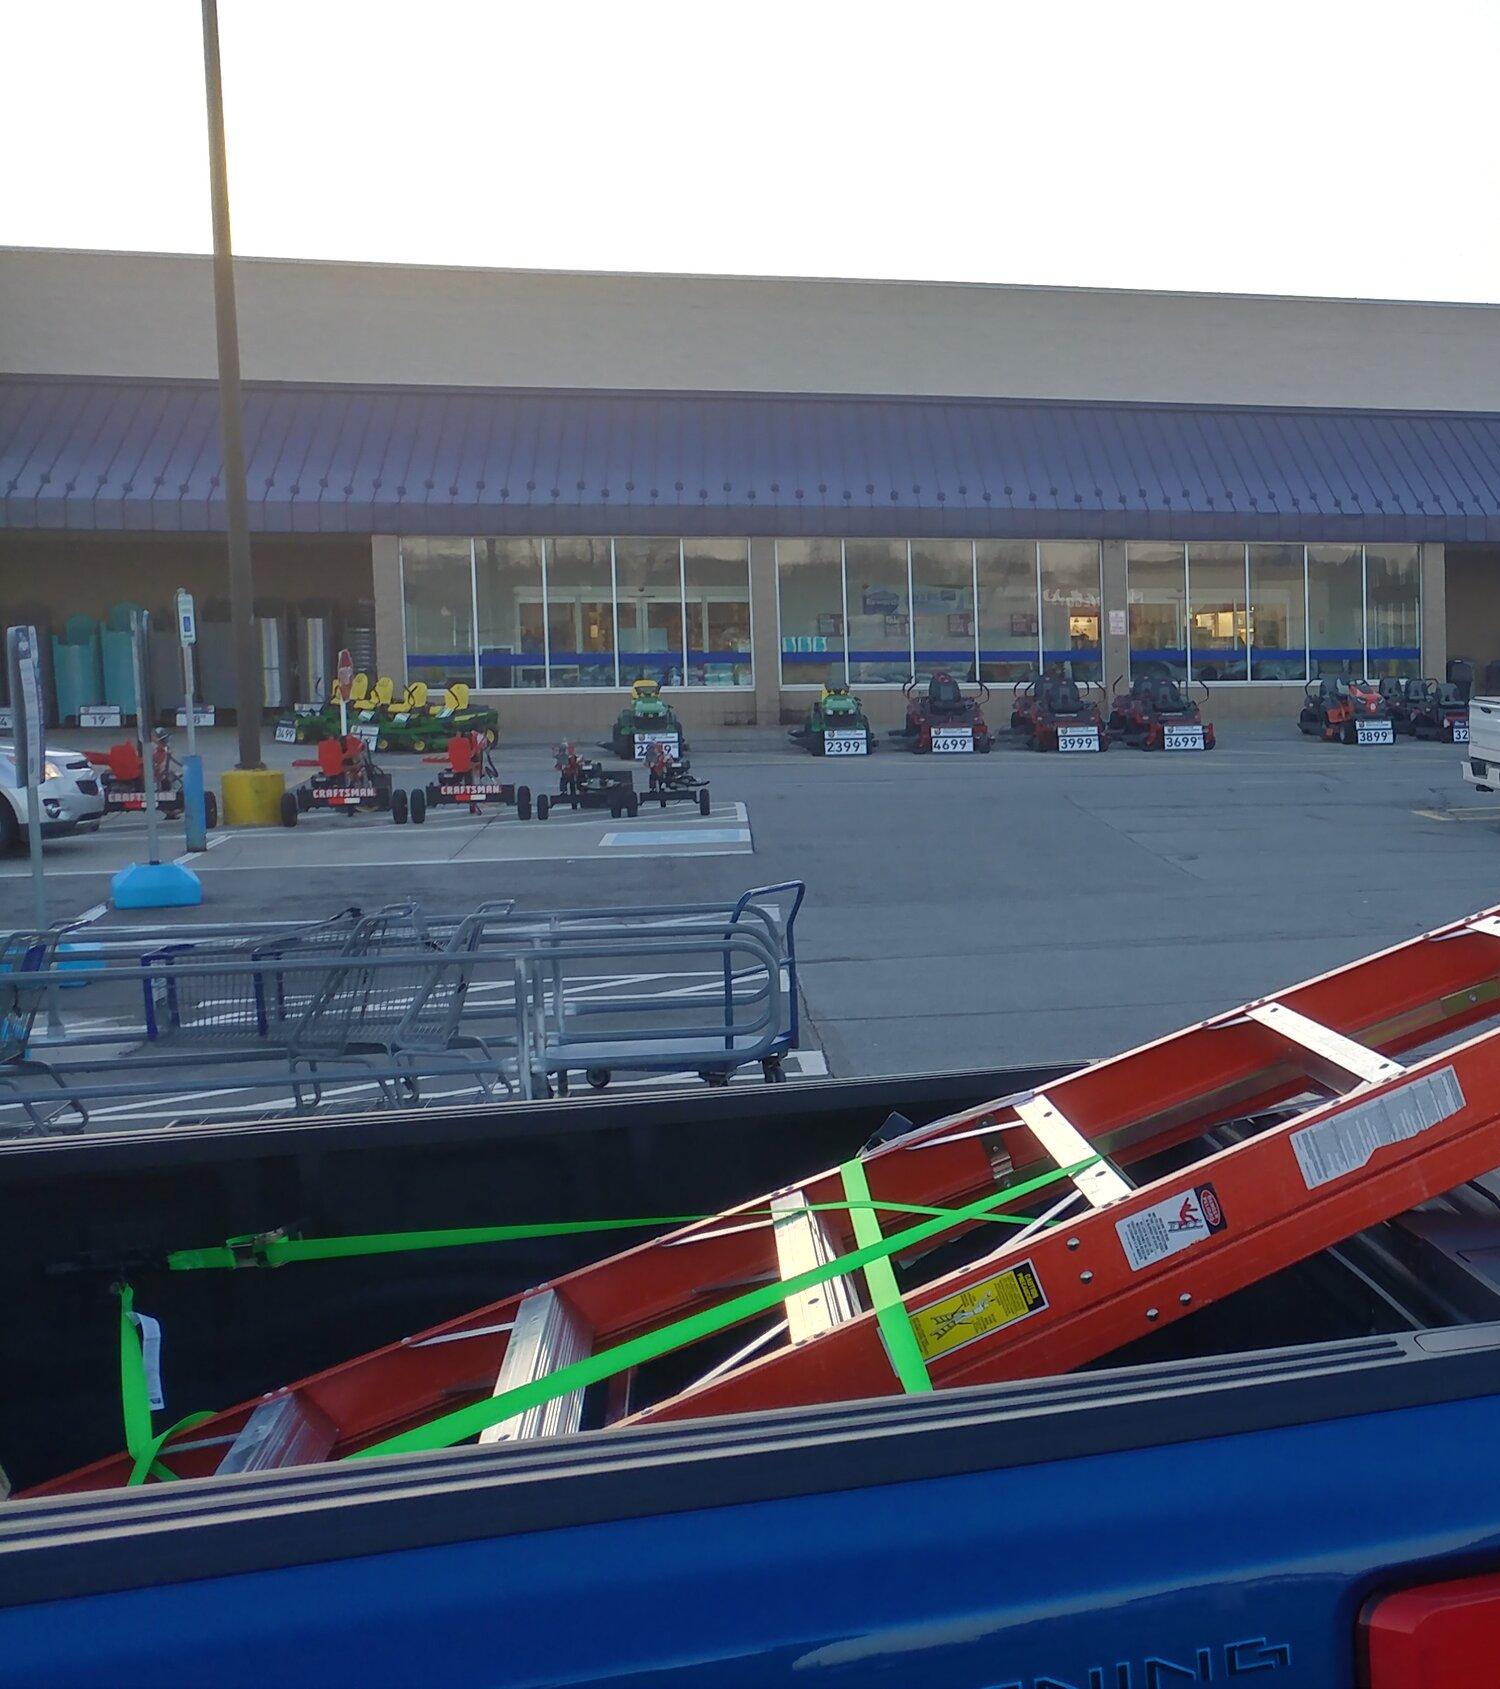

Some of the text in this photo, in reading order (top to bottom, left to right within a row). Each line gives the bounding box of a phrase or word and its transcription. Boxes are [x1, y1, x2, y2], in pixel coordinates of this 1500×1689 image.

[1359, 731, 1389, 742] 3899
[1454, 729, 1469, 740] 32
[827, 741, 860, 752] 2399
[933, 739, 967, 750] 4699
[1060, 738, 1093, 749] 3999
[1166, 737, 1198, 748] 3699
[312, 787, 377, 798] CRAFTSMAN
[441, 785, 502, 795] CRAFTSMAN
